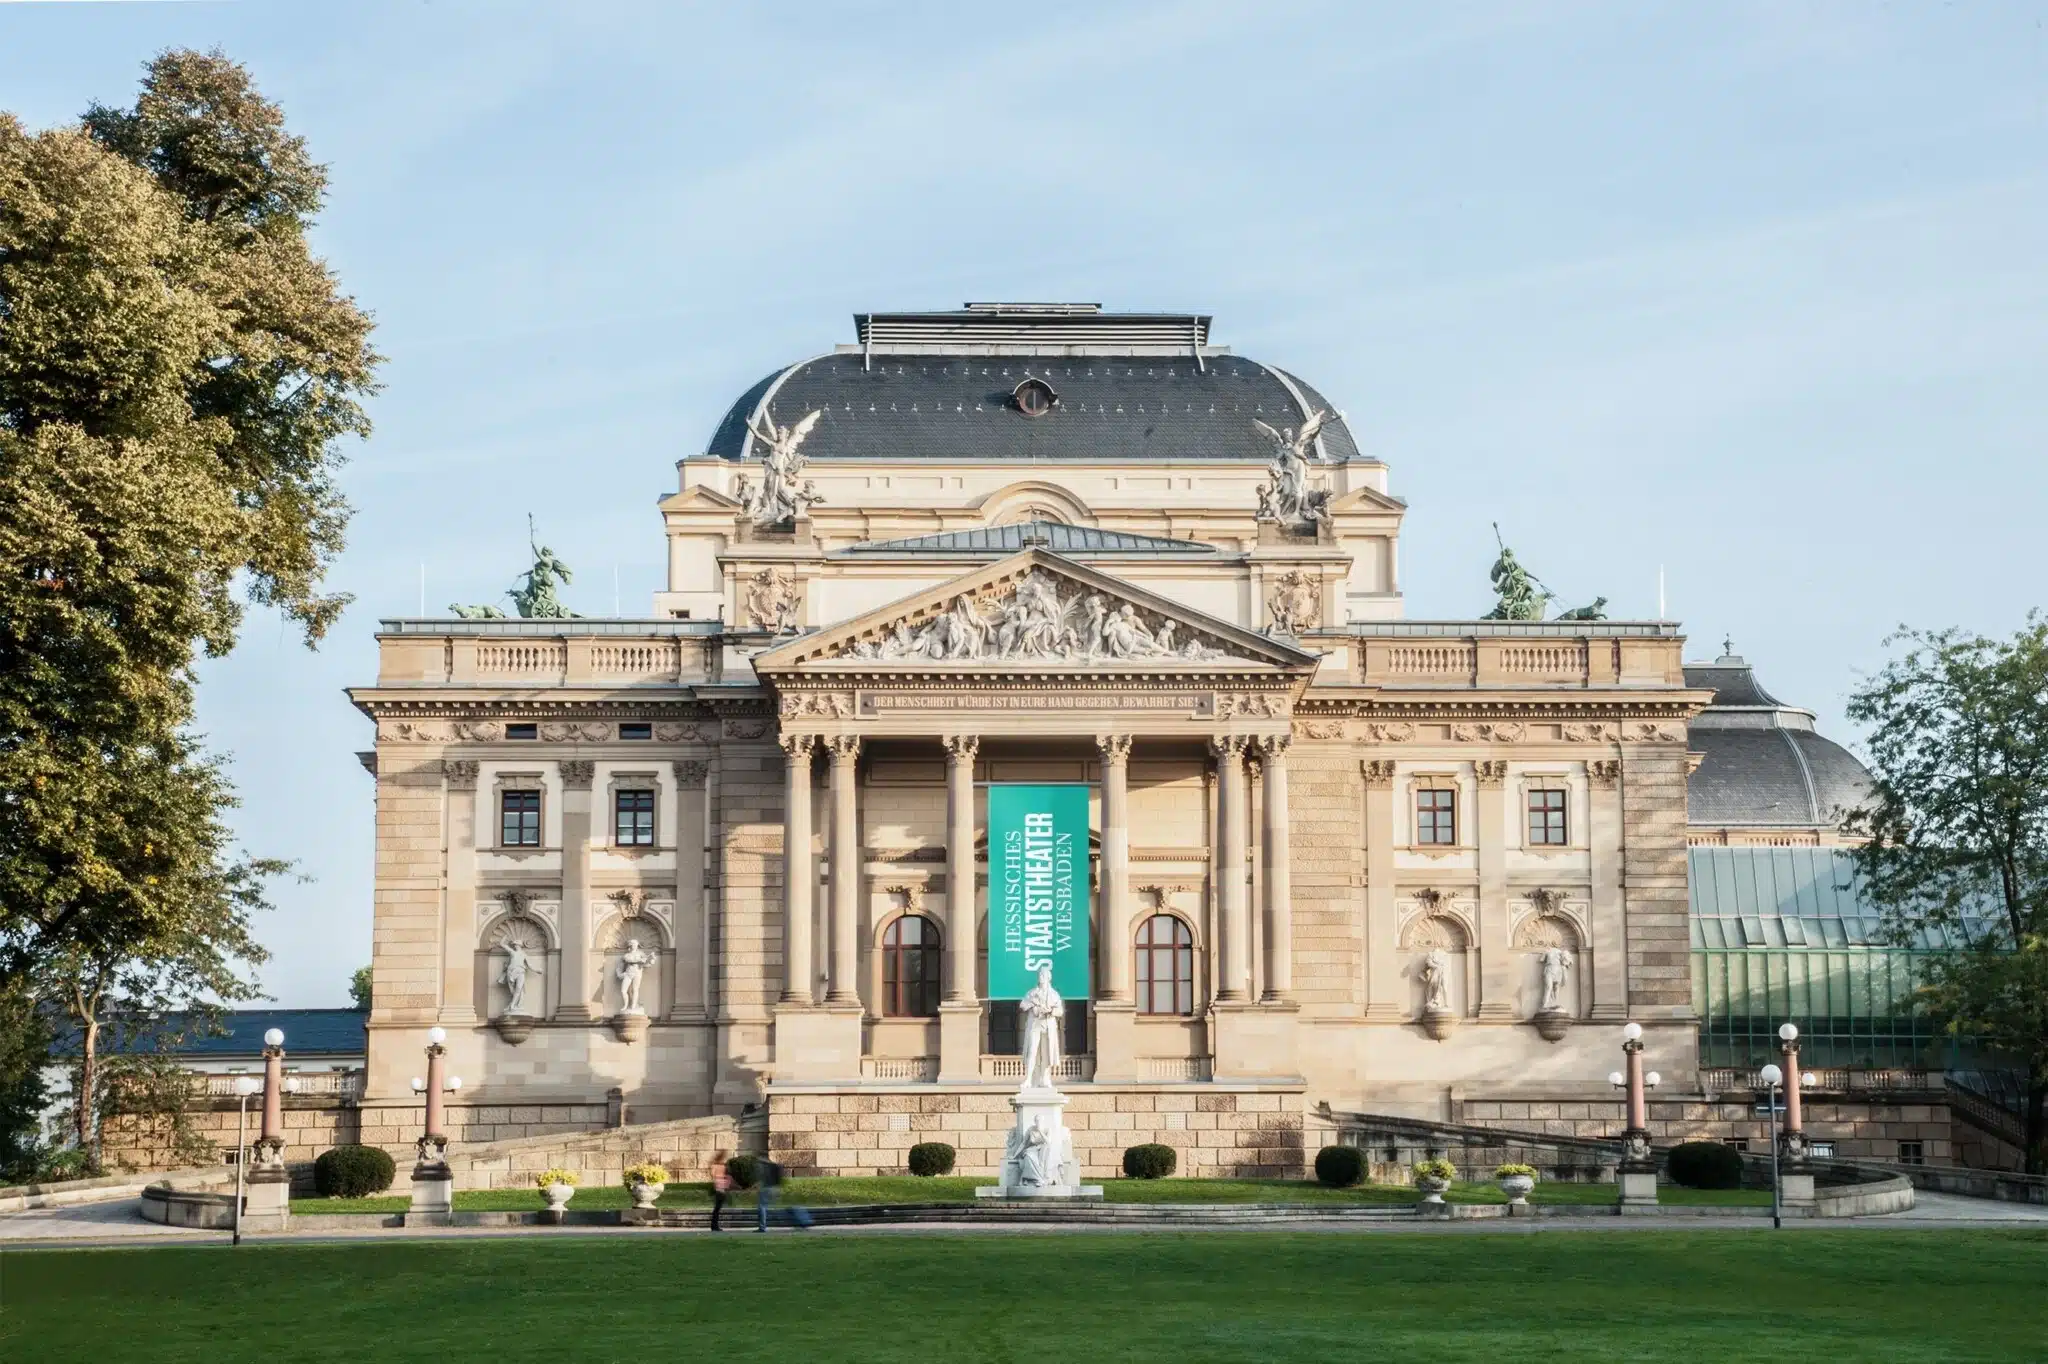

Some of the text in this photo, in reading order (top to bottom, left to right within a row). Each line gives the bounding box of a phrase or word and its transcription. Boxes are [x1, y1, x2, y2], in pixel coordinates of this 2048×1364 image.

[874, 696, 895, 708] DER
[895, 696, 956, 708] MENSCHHEIT
[957, 694, 991, 708] WÜRDE
[993, 696, 1009, 708] IST
[1010, 696, 1020, 708] IN
[1020, 696, 1046, 708] EURE
[1048, 696, 1074, 708] HAND
[1123, 696, 1176, 708] BEWAHRET
[1005, 830, 1021, 952] HESSISCHES
[1025, 812, 1053, 972] STAATSTHEATER
[1056, 832, 1073, 952] WIESBADEN
